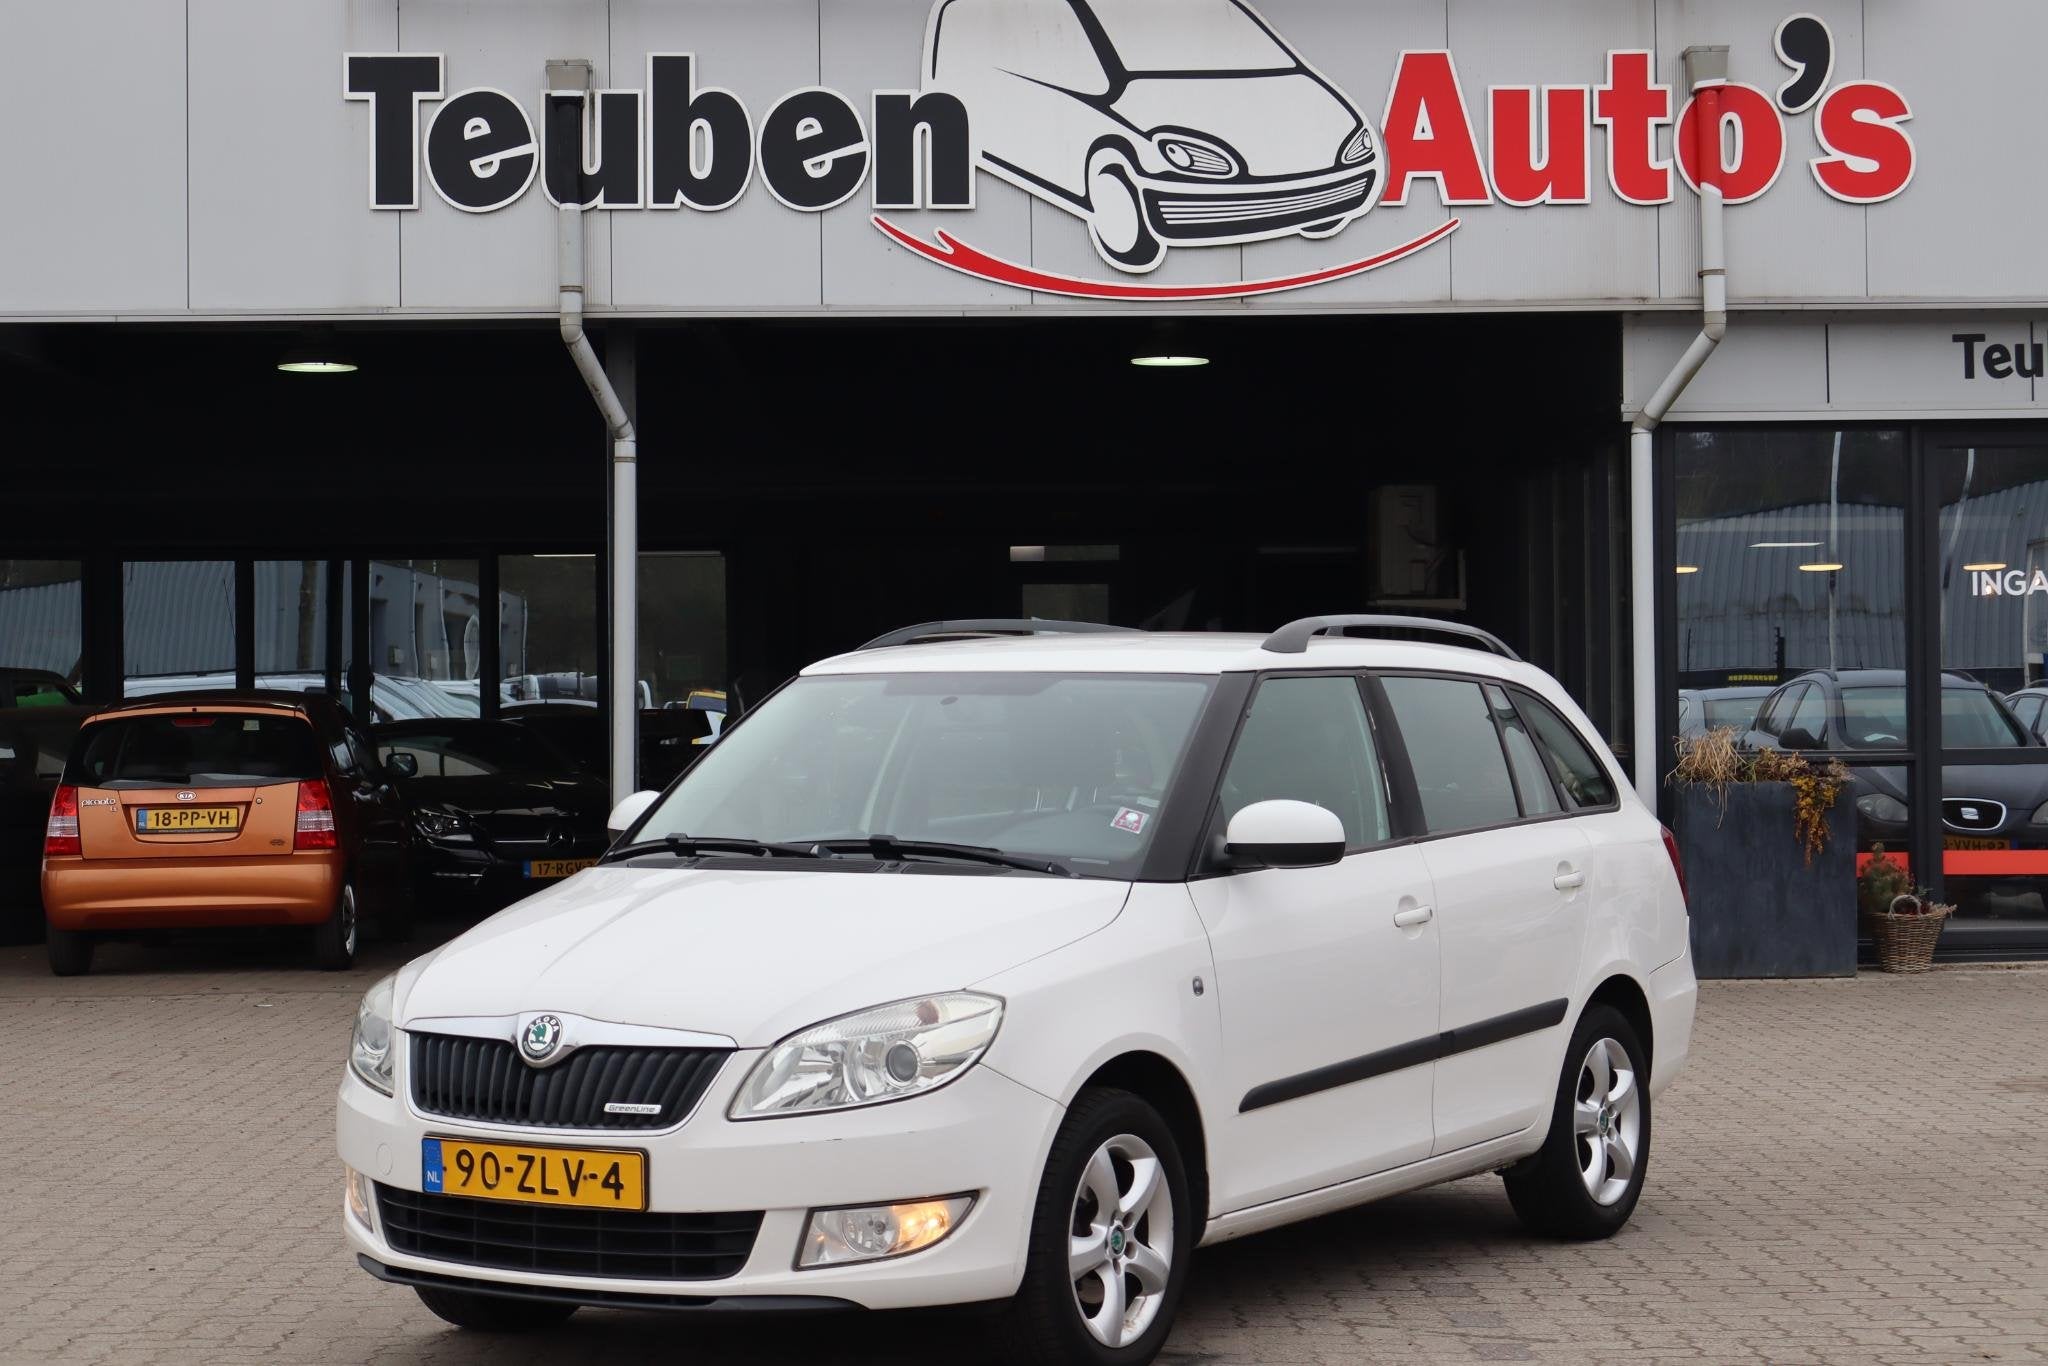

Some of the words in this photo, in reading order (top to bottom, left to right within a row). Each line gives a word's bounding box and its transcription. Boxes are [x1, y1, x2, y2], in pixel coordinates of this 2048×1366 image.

[345, 54, 972, 209] Teuben
[1382, 13, 1915, 206] Auto's
[1952, 333, 2048, 379] Teu
[178, 791, 196, 799] KIA
[153, 811, 230, 827] 18-PP-VH
[426, 1170, 441, 1183] NL
[455, 1148, 625, 1200] 90-ZLV-4
